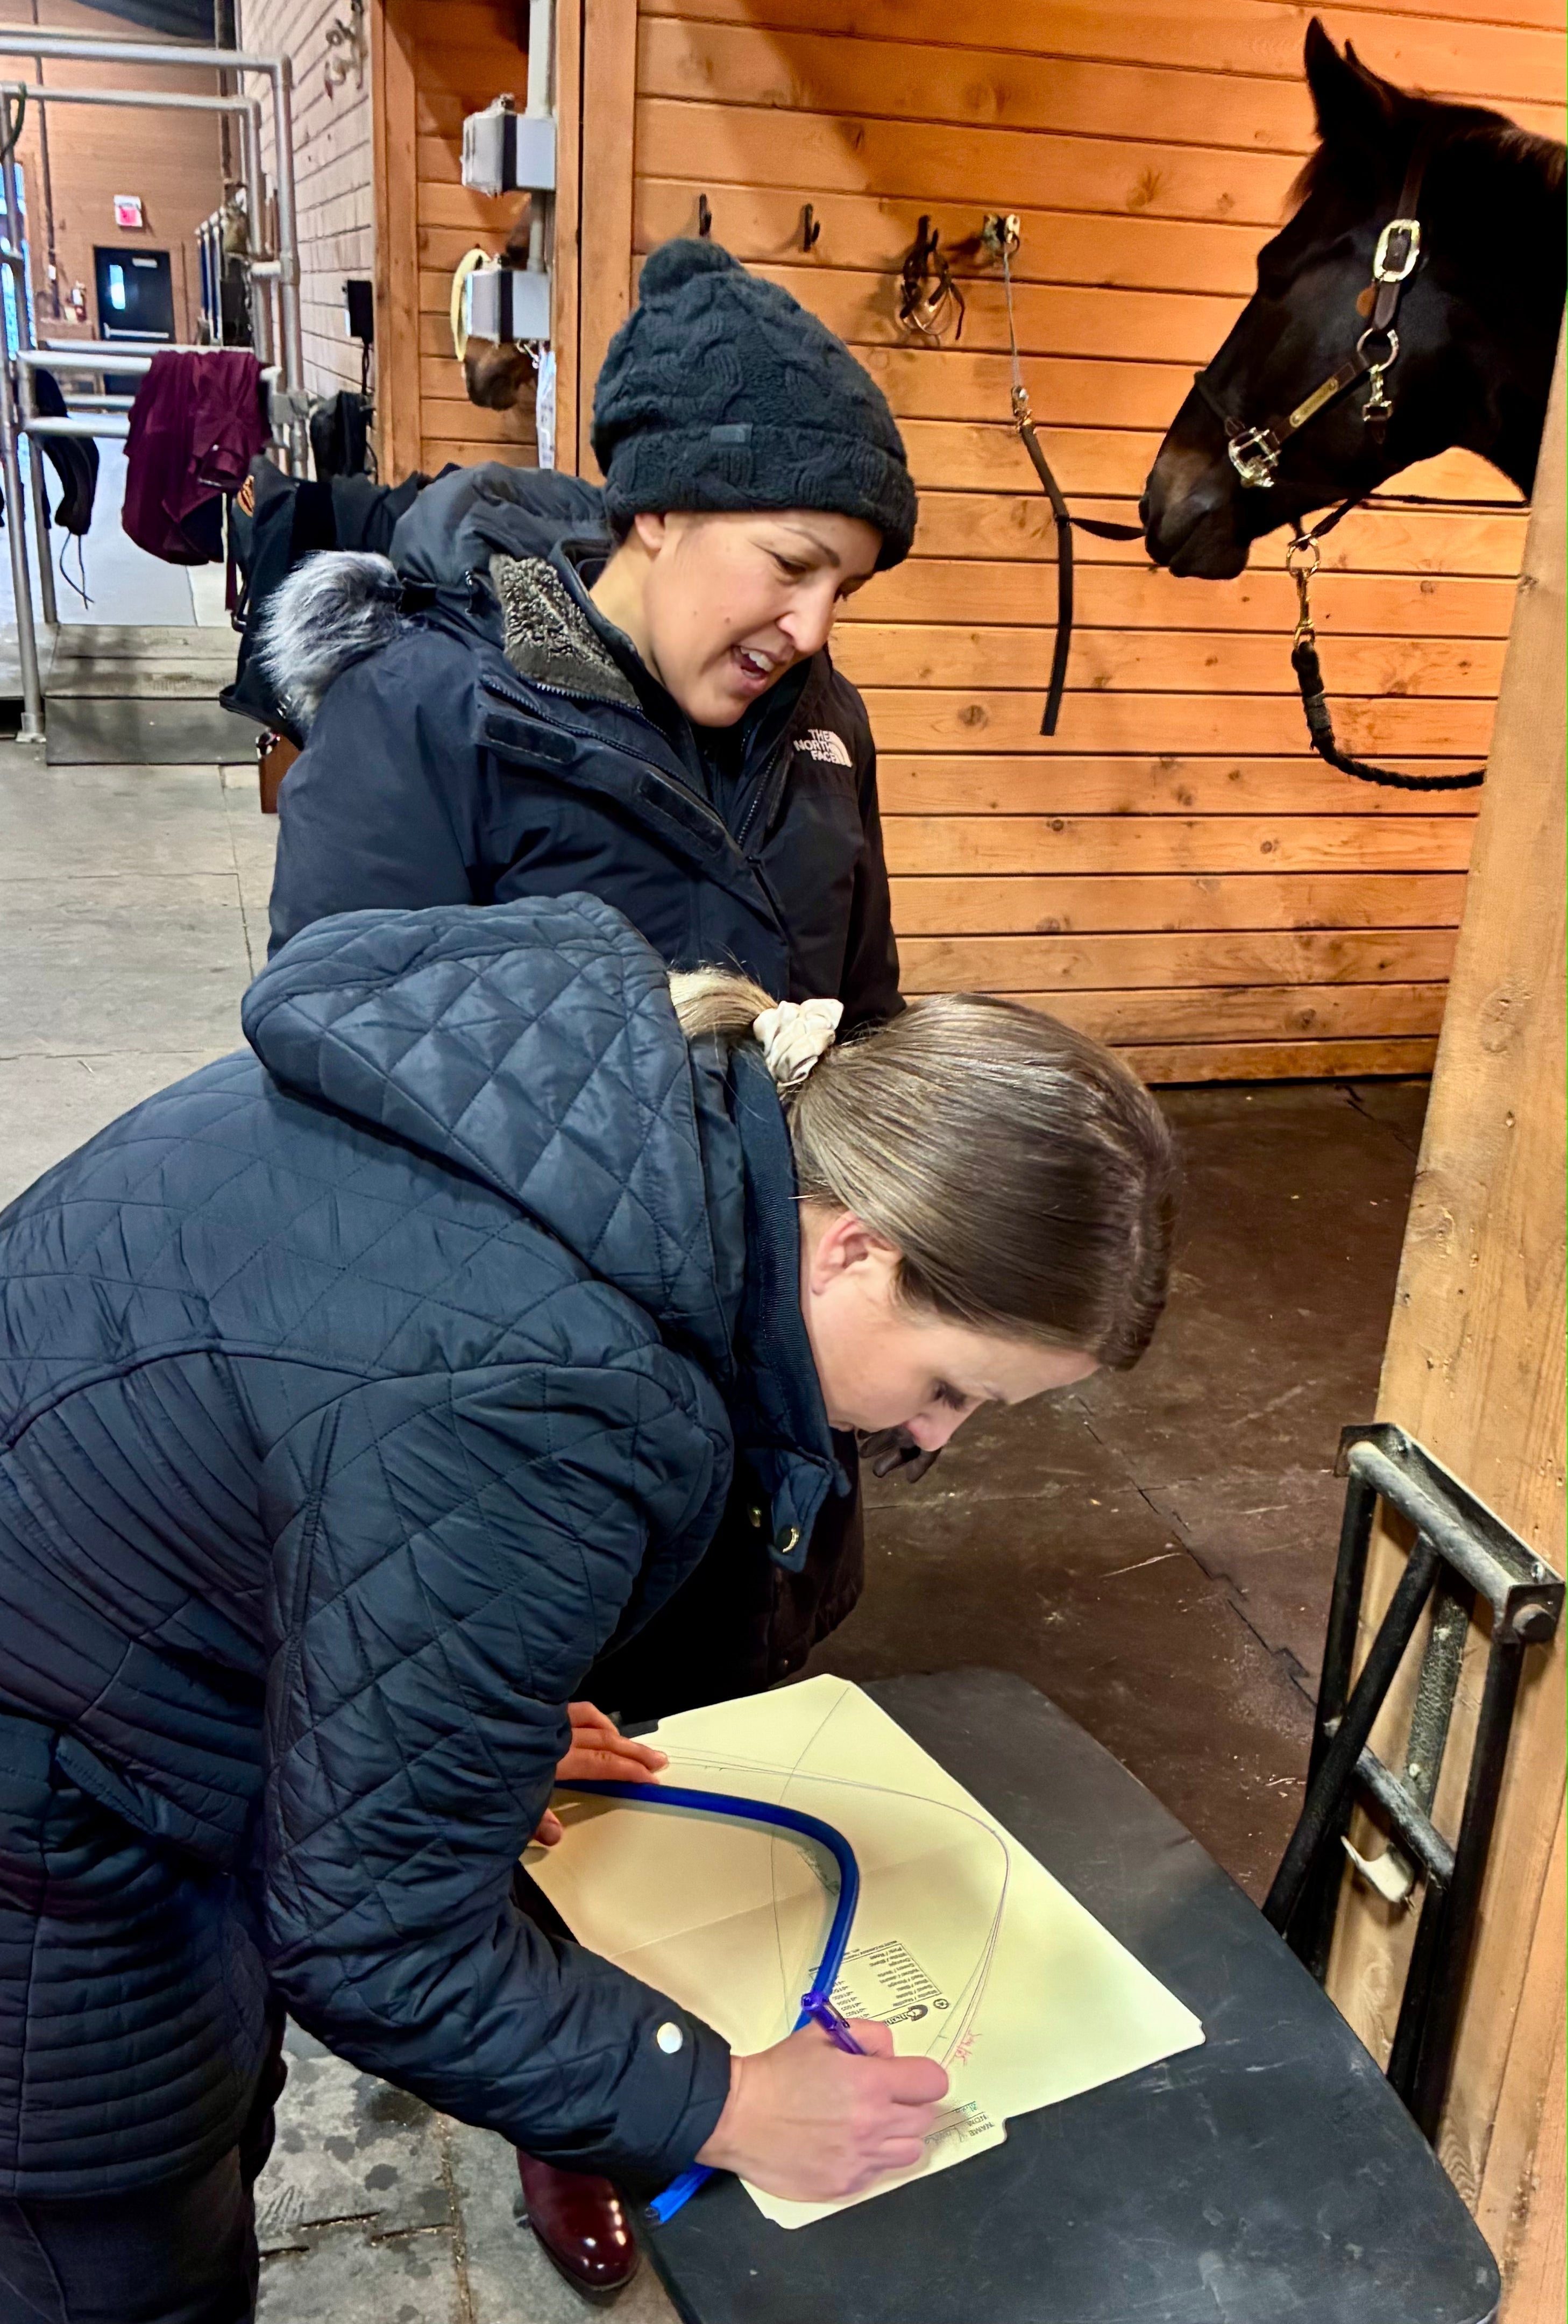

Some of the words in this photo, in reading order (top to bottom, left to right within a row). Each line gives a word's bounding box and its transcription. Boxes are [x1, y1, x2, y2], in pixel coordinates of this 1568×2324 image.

[807, 729, 830, 742] THE
[793, 739, 832, 752] NORTH
[811, 750, 837, 764] FACE
[968, 2122, 995, 2136] NAME
